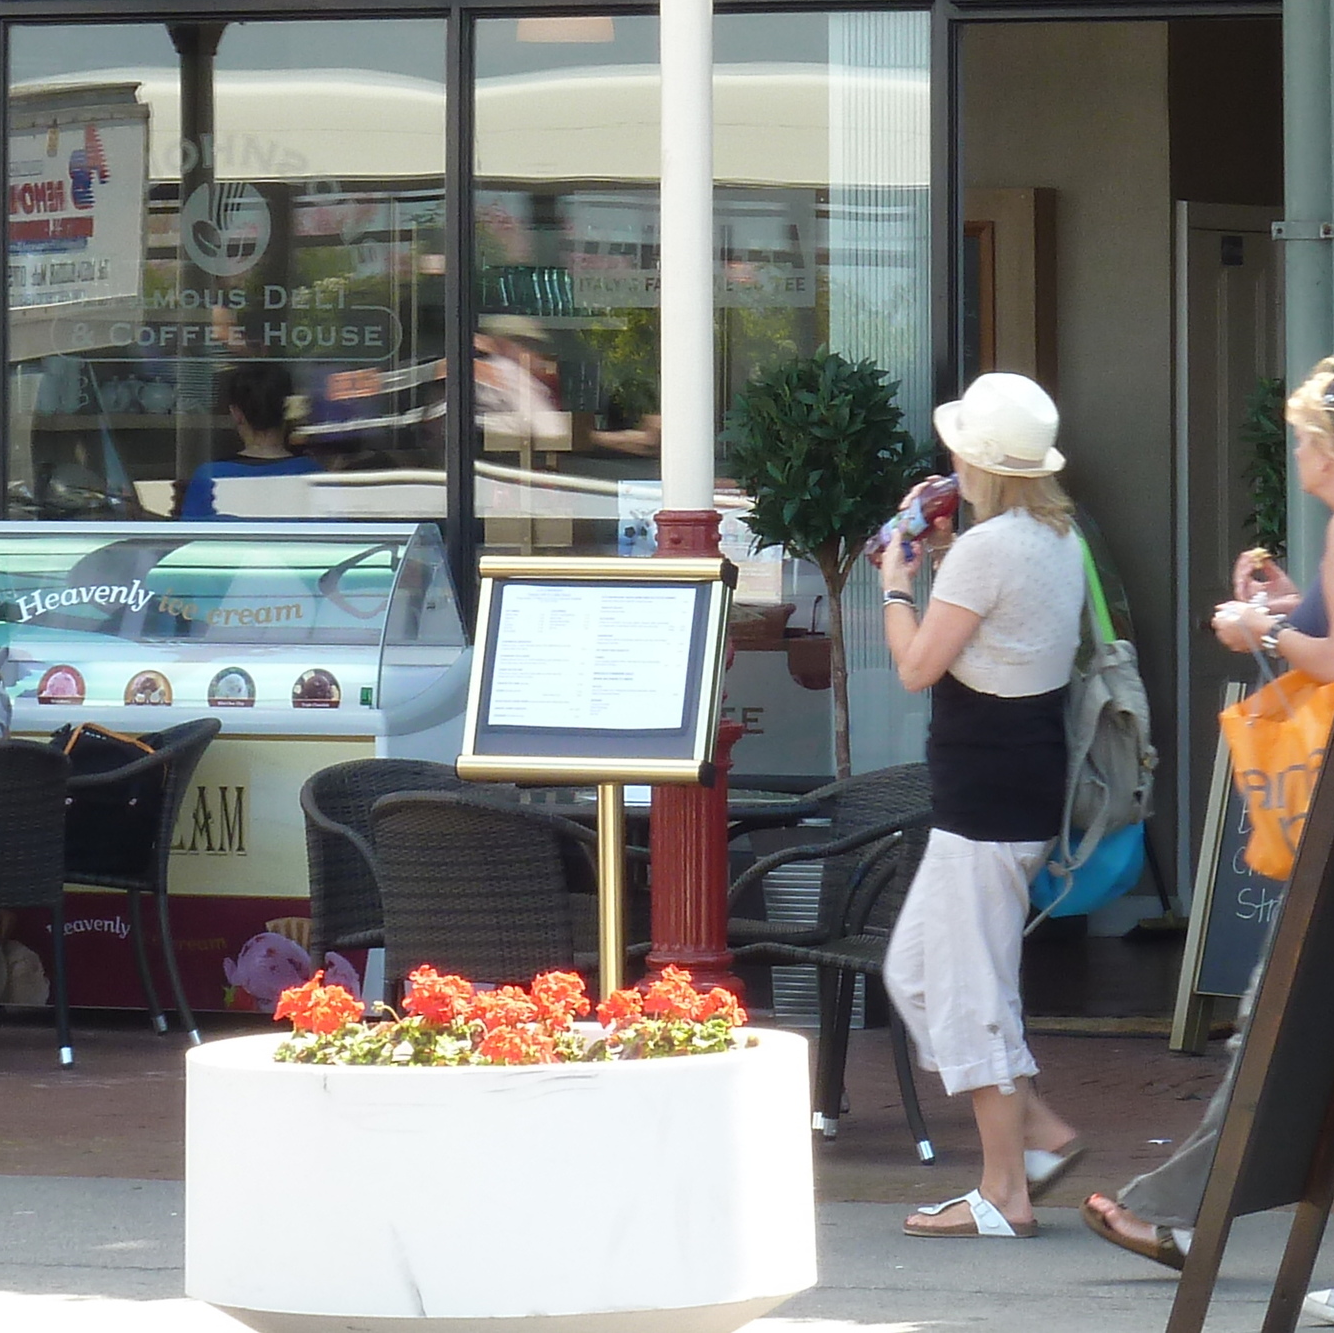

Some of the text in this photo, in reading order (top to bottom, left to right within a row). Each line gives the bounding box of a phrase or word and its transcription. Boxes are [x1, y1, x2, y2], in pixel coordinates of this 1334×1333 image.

[264, 285, 346, 310] DELI
[70, 322, 384, 347] & COFFEE HOUSE
[16, 580, 304, 626] Heavenly ice cream
[46, 916, 132, 939] eavenly
